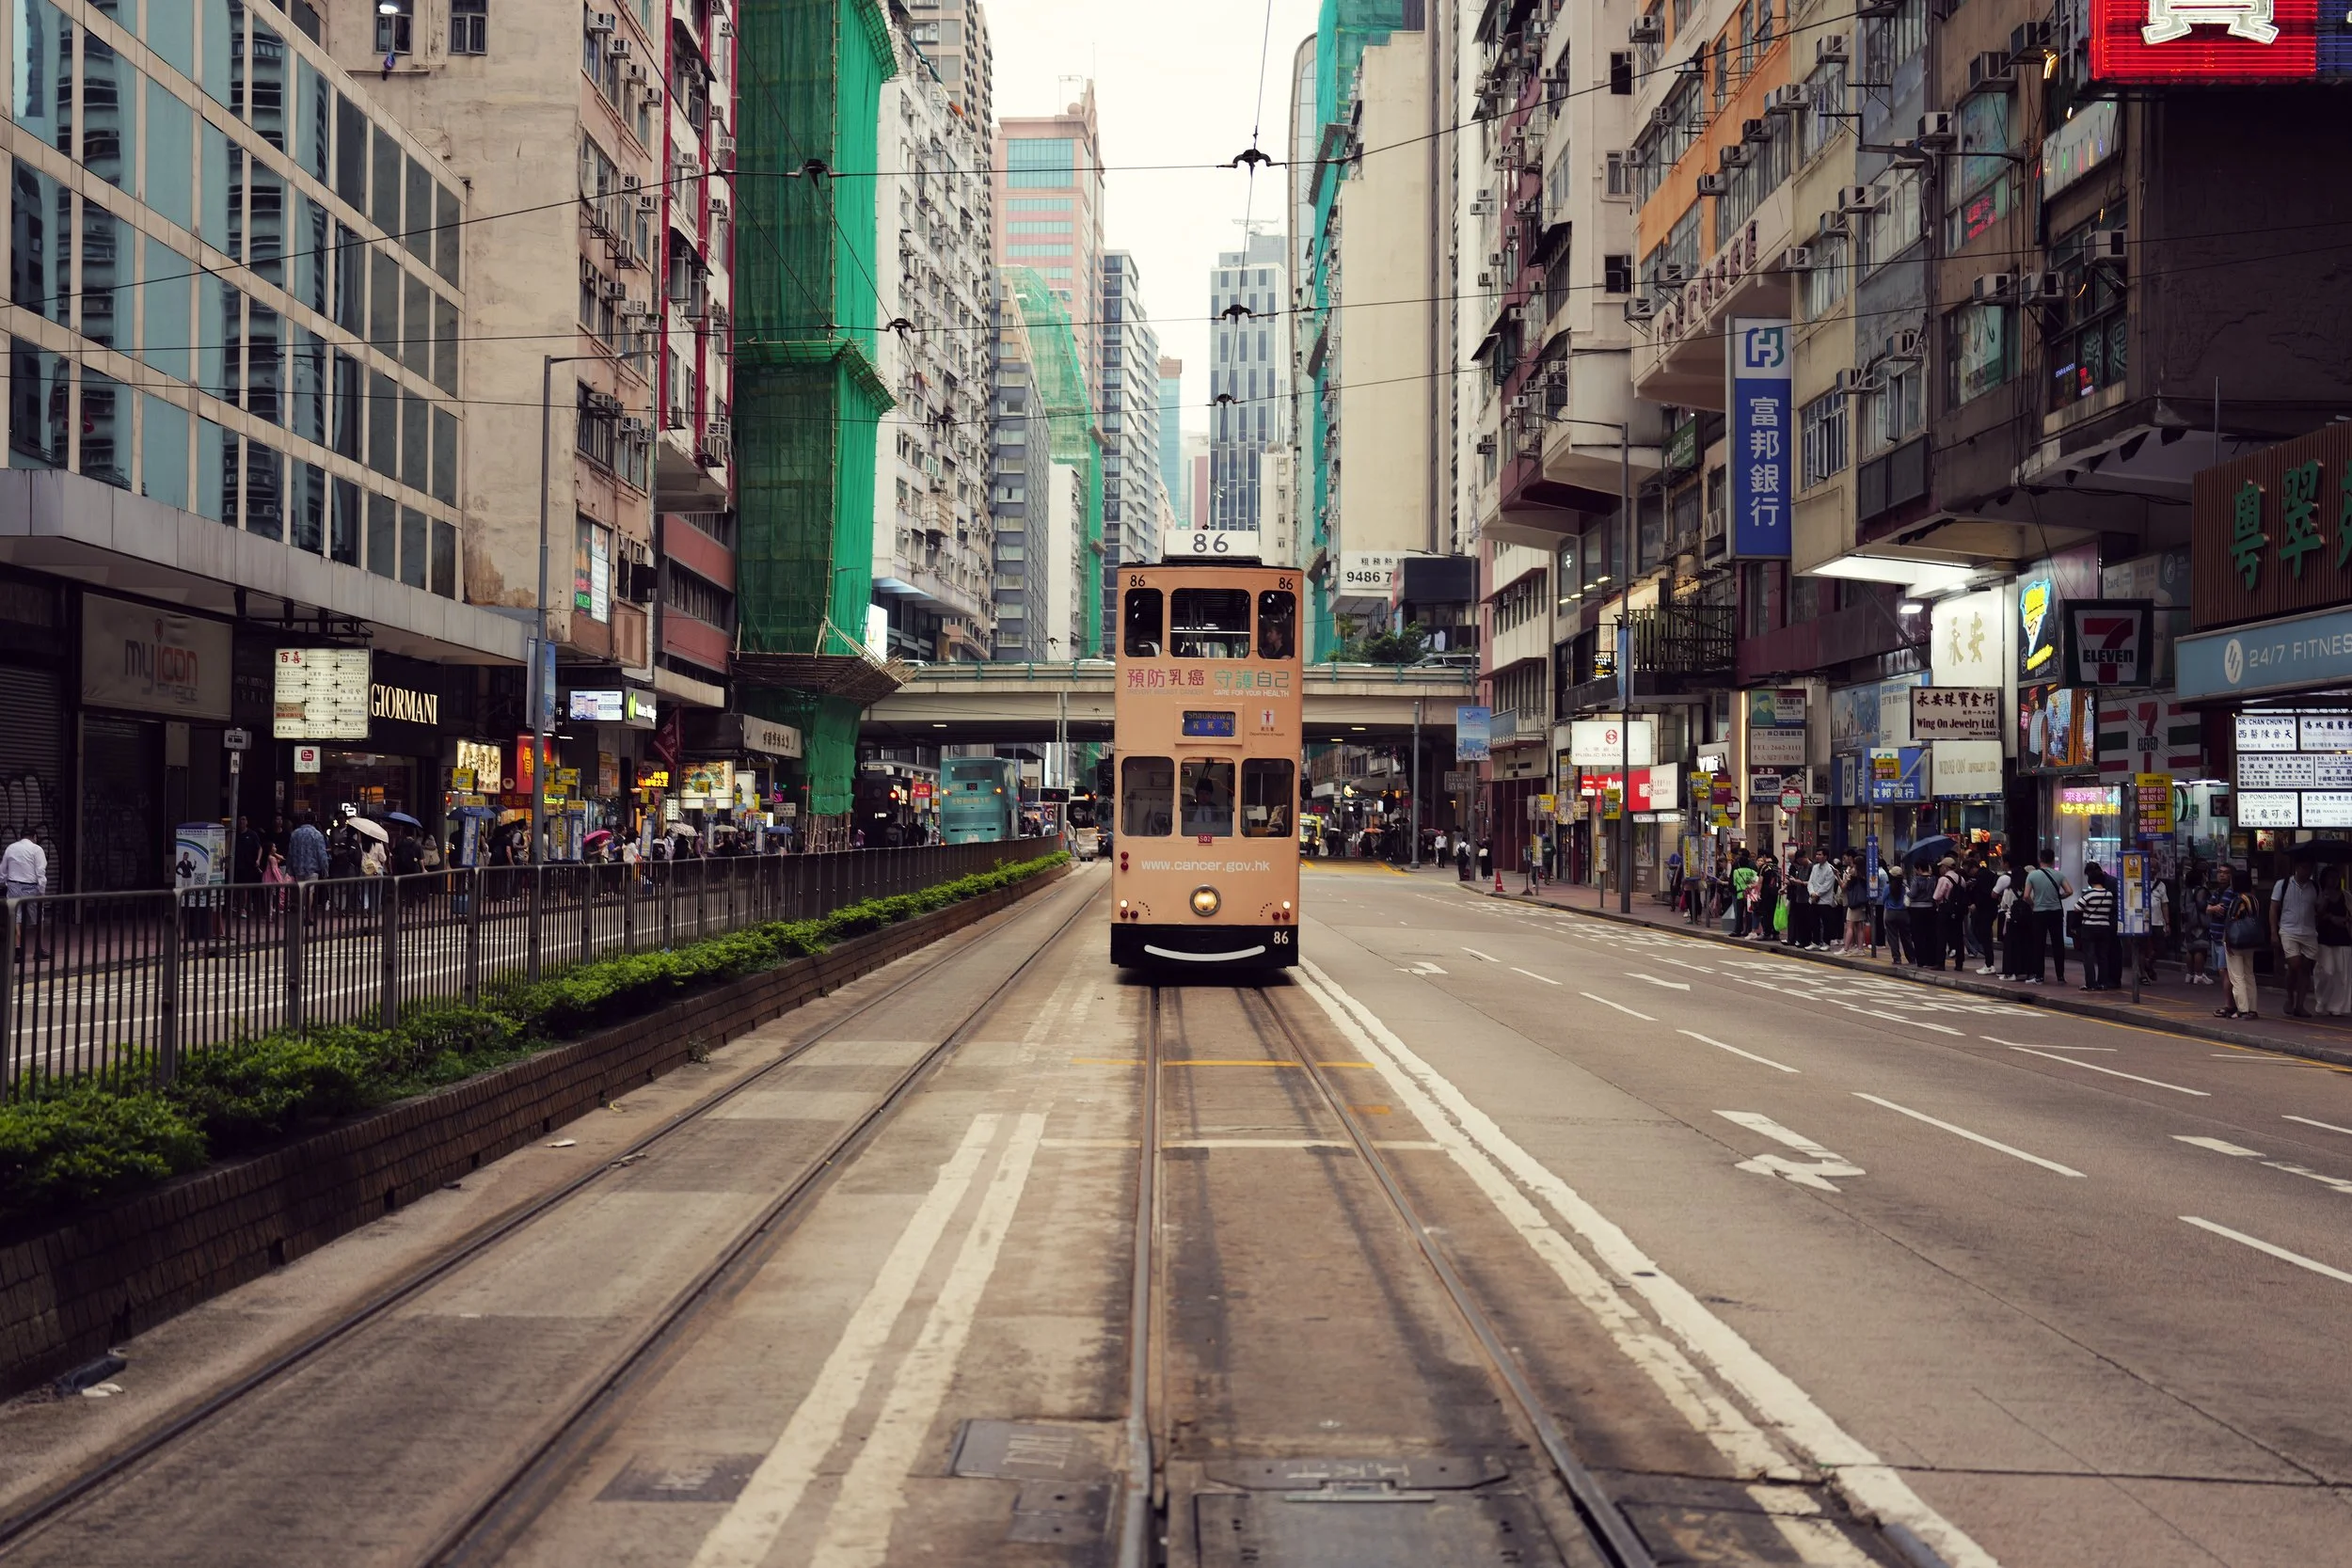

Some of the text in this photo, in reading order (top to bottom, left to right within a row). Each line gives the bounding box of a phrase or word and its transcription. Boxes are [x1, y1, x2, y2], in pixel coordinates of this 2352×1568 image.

[1750, 396, 1780, 527] 富邦銀行
[1192, 532, 1230, 553] 86
[1130, 575, 1146, 587] 86
[1279, 578, 1294, 591] 86
[1346, 571, 1381, 582] 9486
[1948, 611, 1985, 667] 永安
[2249, 644, 2285, 668] 24/7
[1127, 669, 1290, 689] 預防乳癌 守護自己
[372, 683, 438, 725] GIORMANI
[1916, 691, 1996, 708] 永安珠寶金行
[1916, 718, 1996, 731] Wing On Jewelry Ltd.
[1141, 859, 1271, 873] www.cancer.gov.hk
[1273, 932, 1289, 945] 86
